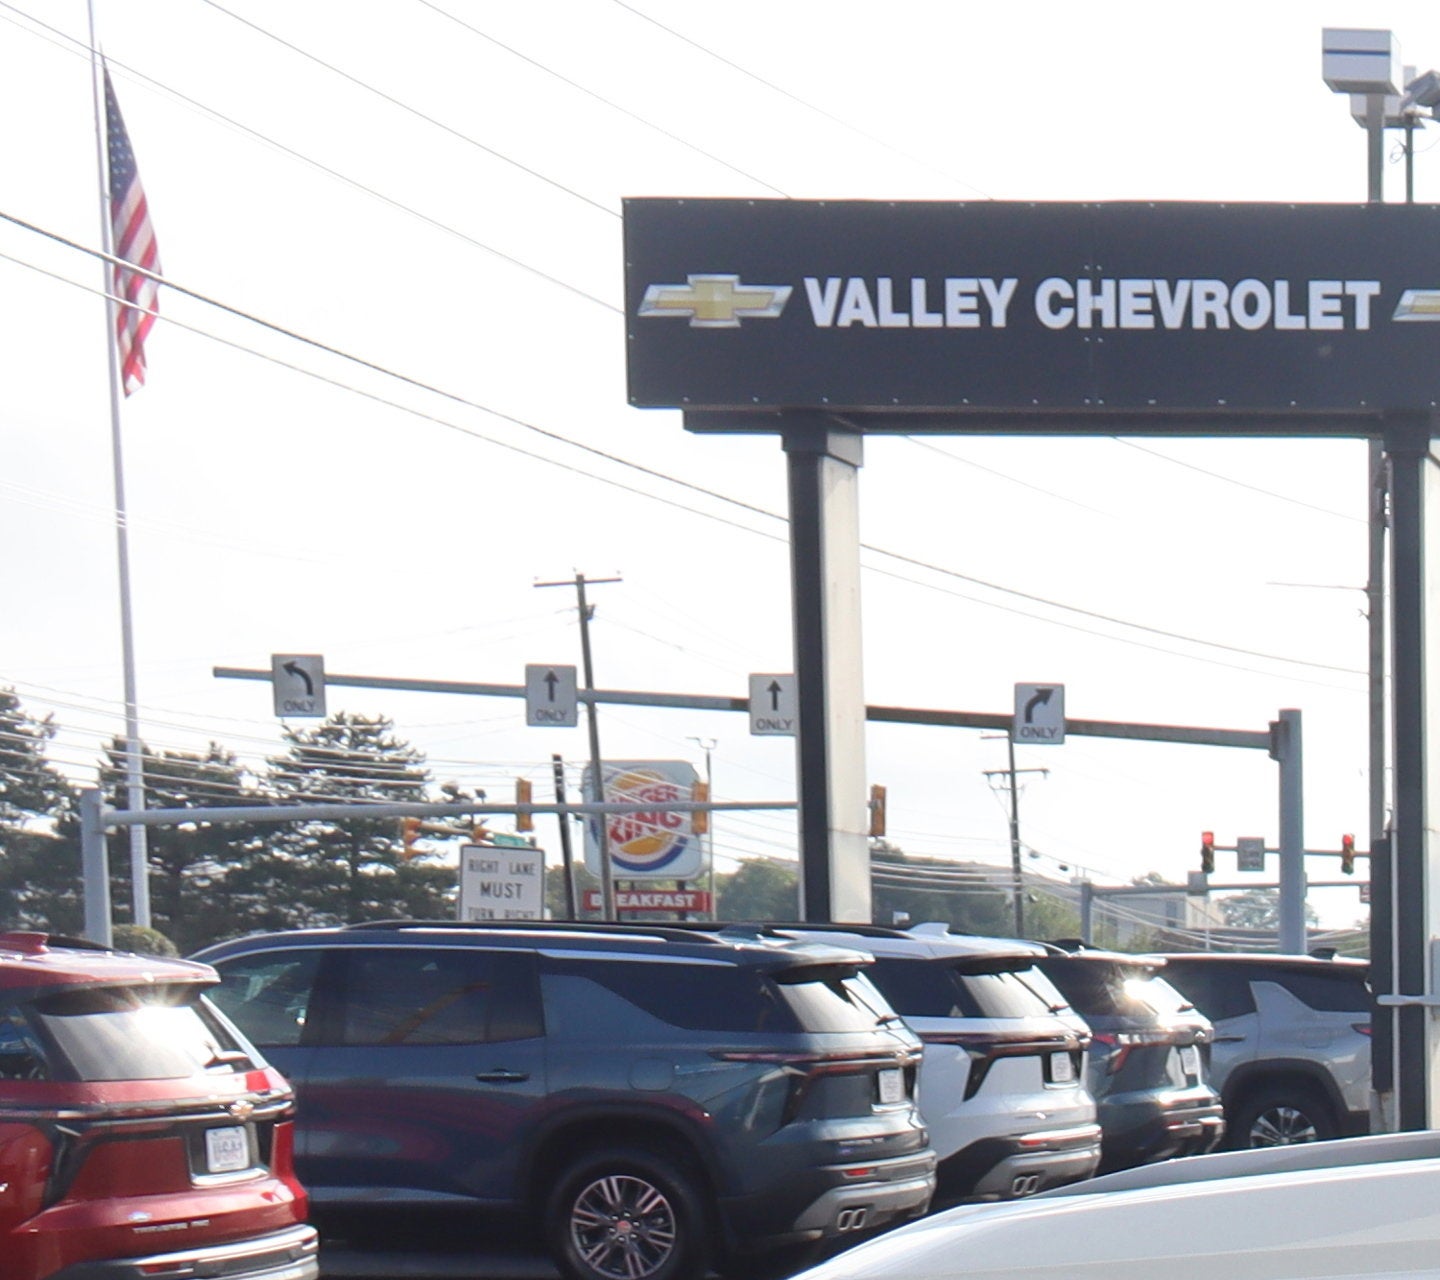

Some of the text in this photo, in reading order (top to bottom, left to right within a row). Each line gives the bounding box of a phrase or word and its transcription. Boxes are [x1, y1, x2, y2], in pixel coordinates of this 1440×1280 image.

[804, 277, 1381, 331] VALLEY CHEVROLET
[283, 700, 316, 712] ONLY
[535, 709, 567, 722] ONLY
[756, 718, 792, 730] ONLY
[1021, 726, 1058, 738] ONLY
[468, 859, 537, 876] RIGHT LANE
[480, 882, 523, 899] MUST
[590, 893, 696, 907] BEAKFAST
